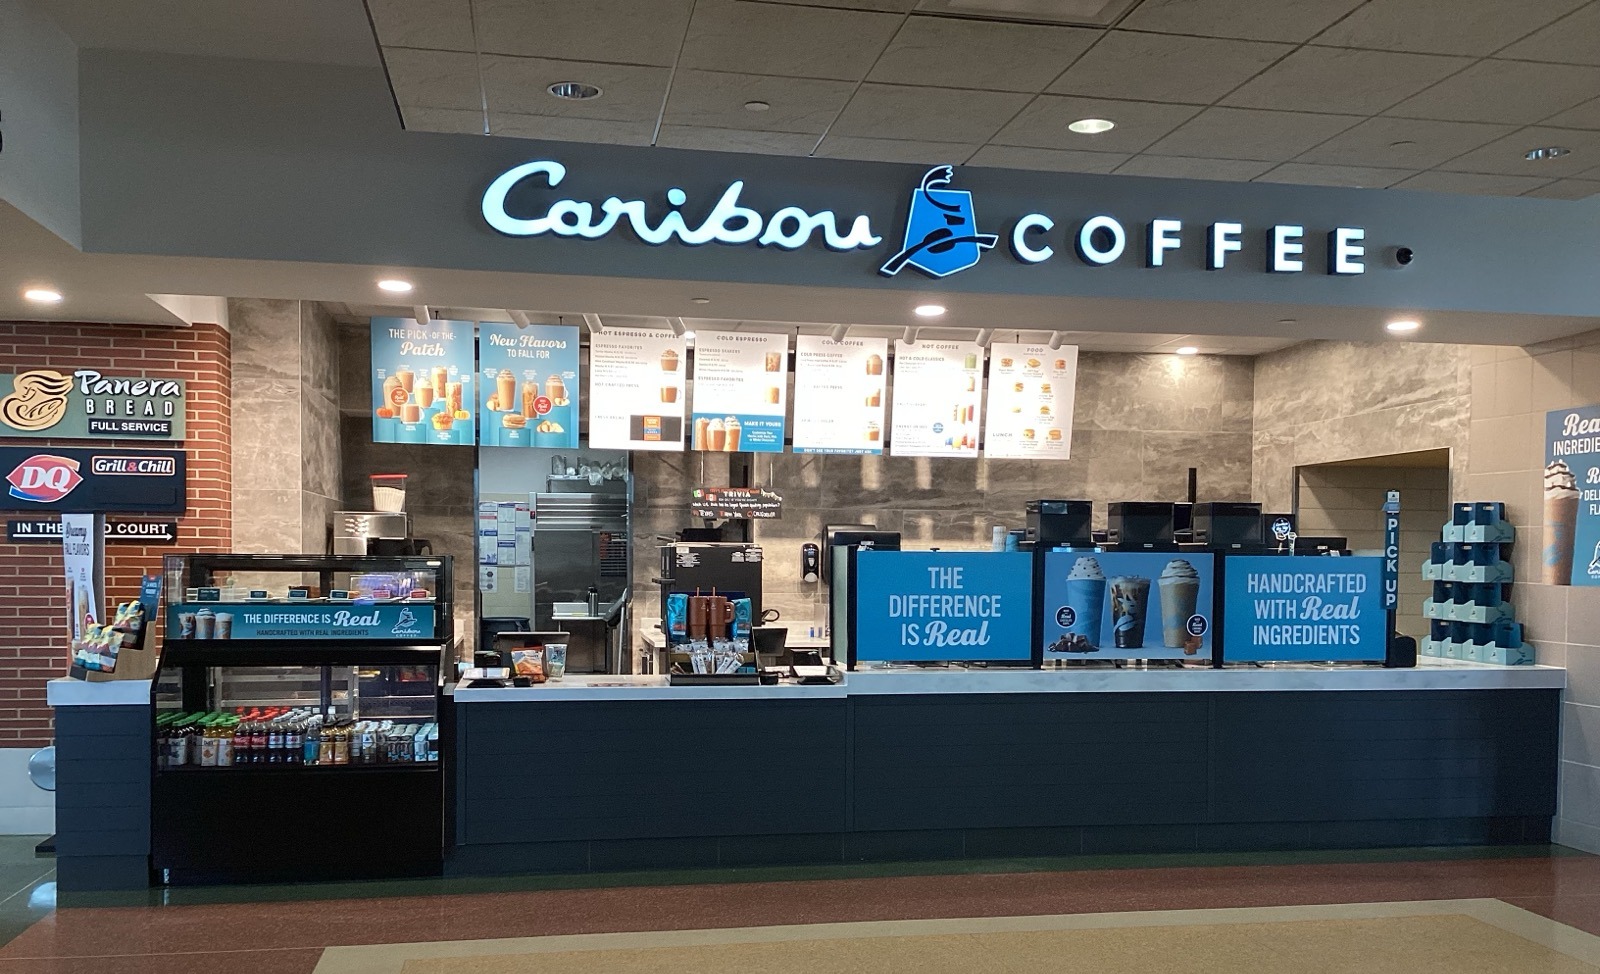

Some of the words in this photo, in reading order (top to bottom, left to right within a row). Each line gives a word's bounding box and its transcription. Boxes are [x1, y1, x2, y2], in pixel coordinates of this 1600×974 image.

[481, 160, 883, 250] Caribou
[1010, 213, 1366, 275] COFFEE
[388, 328, 404, 339] THE
[408, 330, 427, 340] PICK
[490, 334, 518, 347] New
[519, 335, 567, 350] Flavors
[400, 341, 446, 357] Patch
[507, 348, 516, 358] TO
[518, 349, 534, 358] FALL
[536, 350, 550, 359] FOR
[74, 370, 181, 397] Panera
[86, 398, 174, 416] BREAD
[91, 422, 118, 430] FULL
[122, 422, 168, 432] SERVICE
[20, 466, 70, 492] DQ
[17, 522, 32, 532] IN
[117, 524, 168, 534] COURT
[1386, 518, 1398, 573] PICK
[928, 567, 964, 589] THE
[1248, 574, 1366, 594] HANDCRAFTED
[1386, 580, 1397, 606] UP
[890, 595, 1001, 618] DIFFERENCE
[1254, 600, 1296, 620] WITH
[1300, 595, 1360, 621] Real
[244, 614, 262, 624] THE
[265, 614, 319, 624] DIFFERENCE
[322, 614, 331, 624] IS
[333, 610, 380, 627] Real
[902, 623, 919, 646] IS
[923, 620, 991, 647] Real
[1253, 624, 1360, 645] INGREDIENTS
